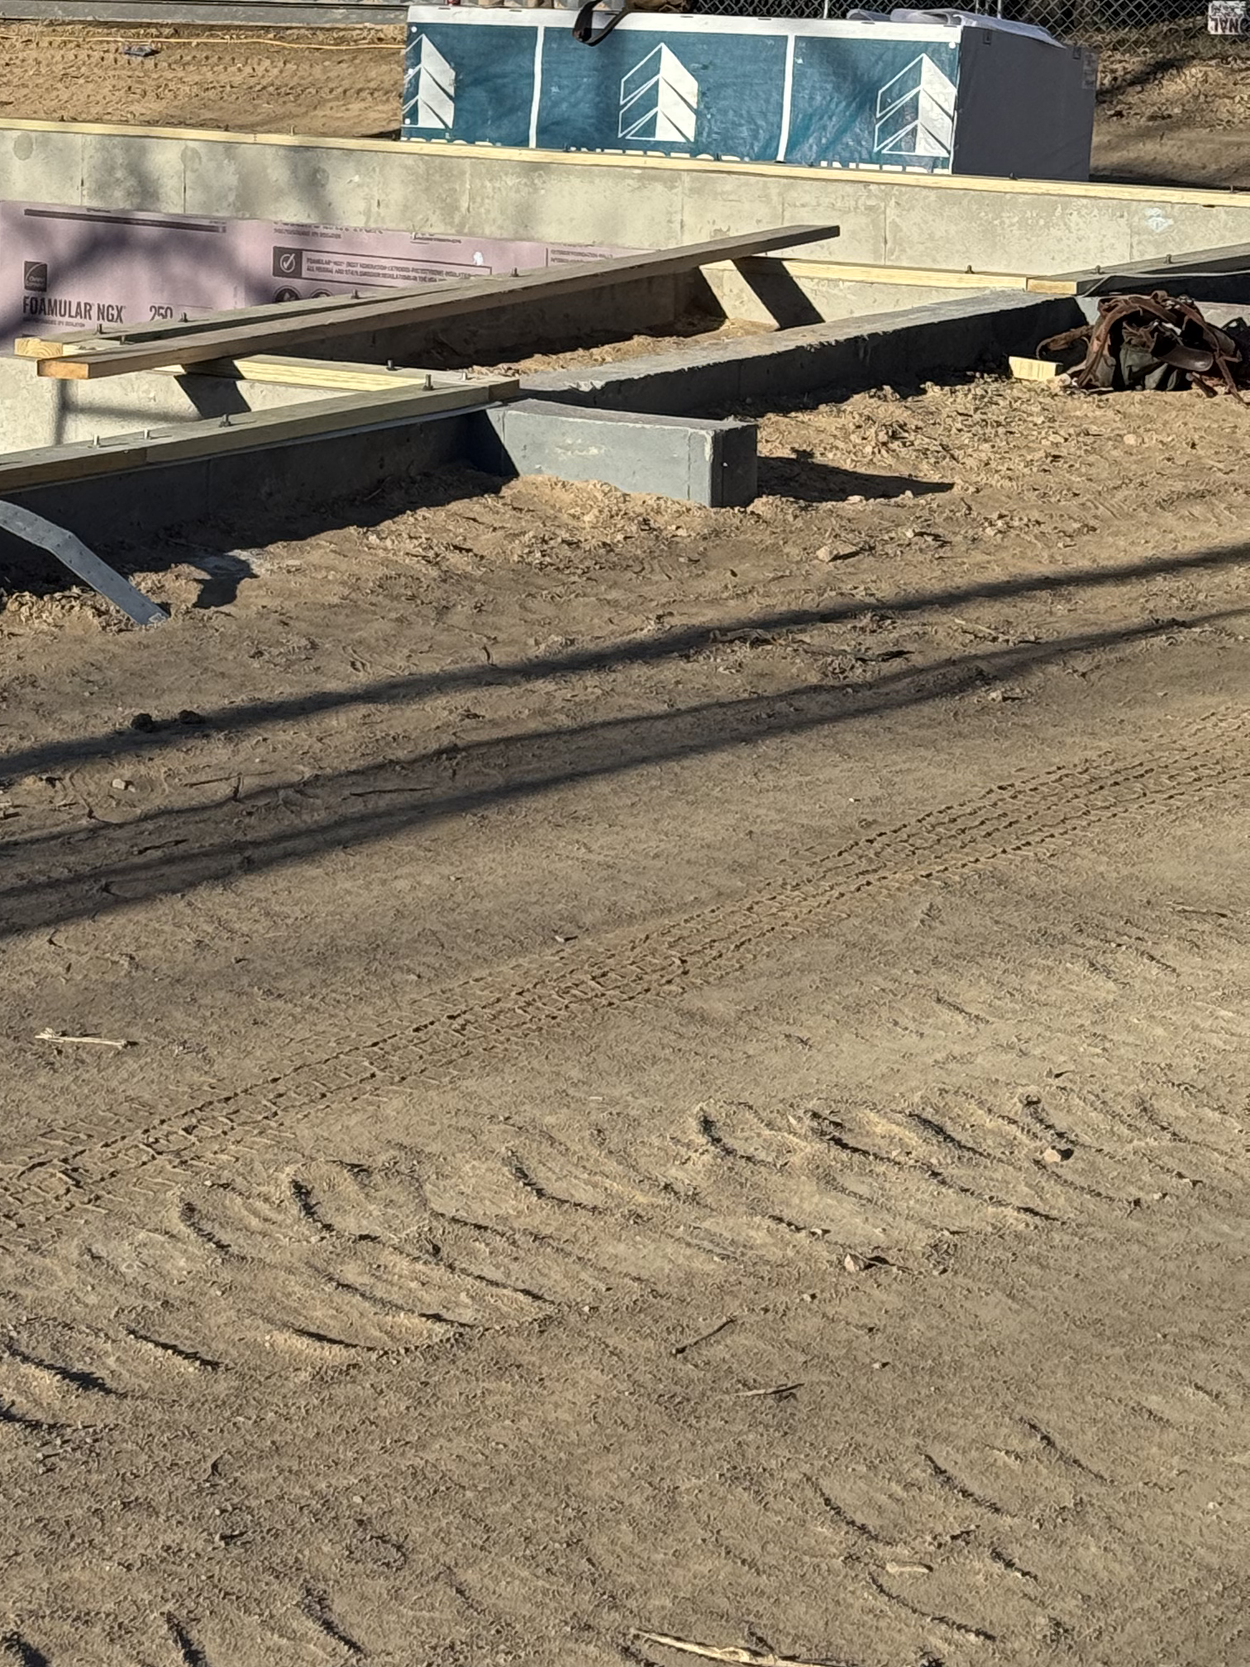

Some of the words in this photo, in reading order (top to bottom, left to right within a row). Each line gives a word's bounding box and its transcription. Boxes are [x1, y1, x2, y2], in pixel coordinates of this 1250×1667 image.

[23, 295, 92, 320] FOAMULAR
[97, 303, 123, 323] NGX
[149, 305, 173, 322] 250
